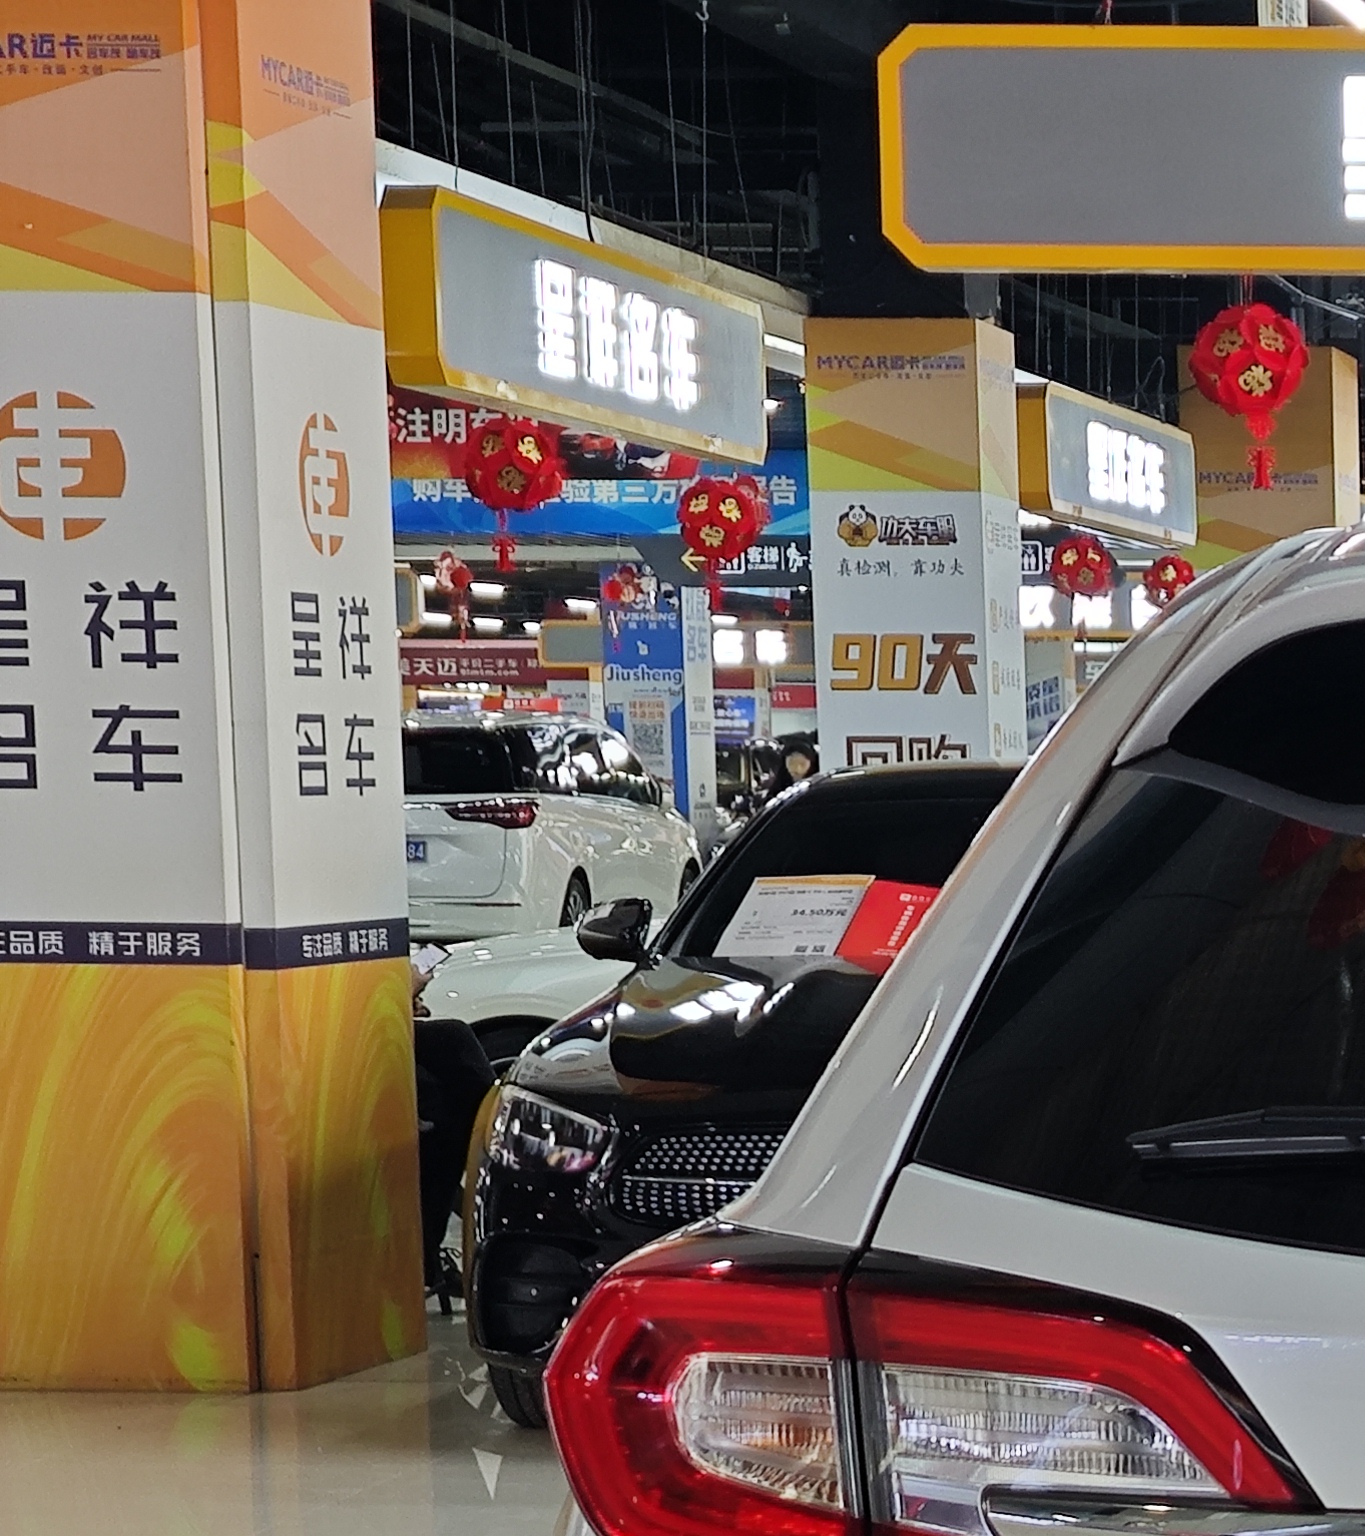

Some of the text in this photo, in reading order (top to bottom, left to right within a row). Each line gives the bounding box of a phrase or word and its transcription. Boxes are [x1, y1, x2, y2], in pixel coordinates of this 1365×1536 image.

[0, 33, 83, 58] R迈卡
[535, 258, 699, 411] 呈祥名车
[291, 591, 370, 680] 呈祥
[830, 633, 978, 695] 90天
[606, 664, 683, 685] Jiusheng
[296, 713, 376, 796] 名车
[88, 931, 202, 957] 精于服务
